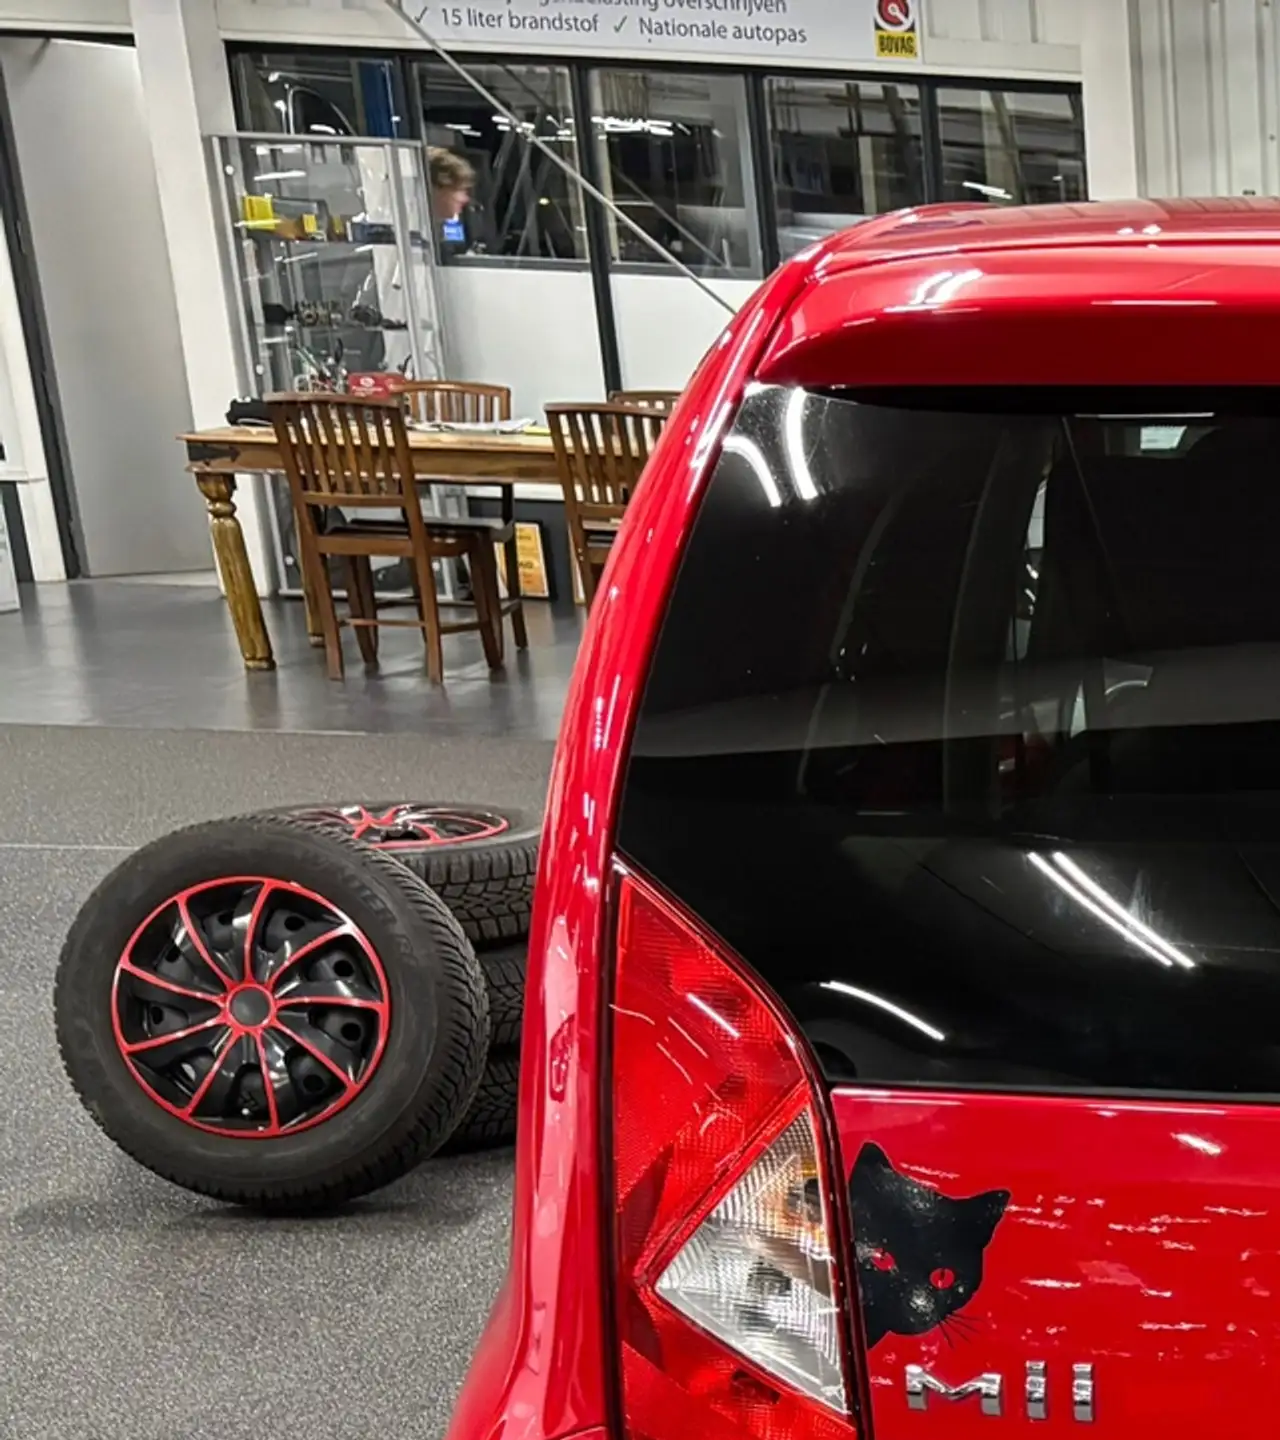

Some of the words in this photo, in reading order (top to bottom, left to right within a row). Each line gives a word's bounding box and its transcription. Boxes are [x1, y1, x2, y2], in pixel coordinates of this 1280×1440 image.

[441, 8, 461, 26] 15
[467, 8, 502, 28] liter
[508, 9, 598, 33] brandstof
[639, 17, 727, 39] Nationale
[732, 24, 807, 46] autopas
